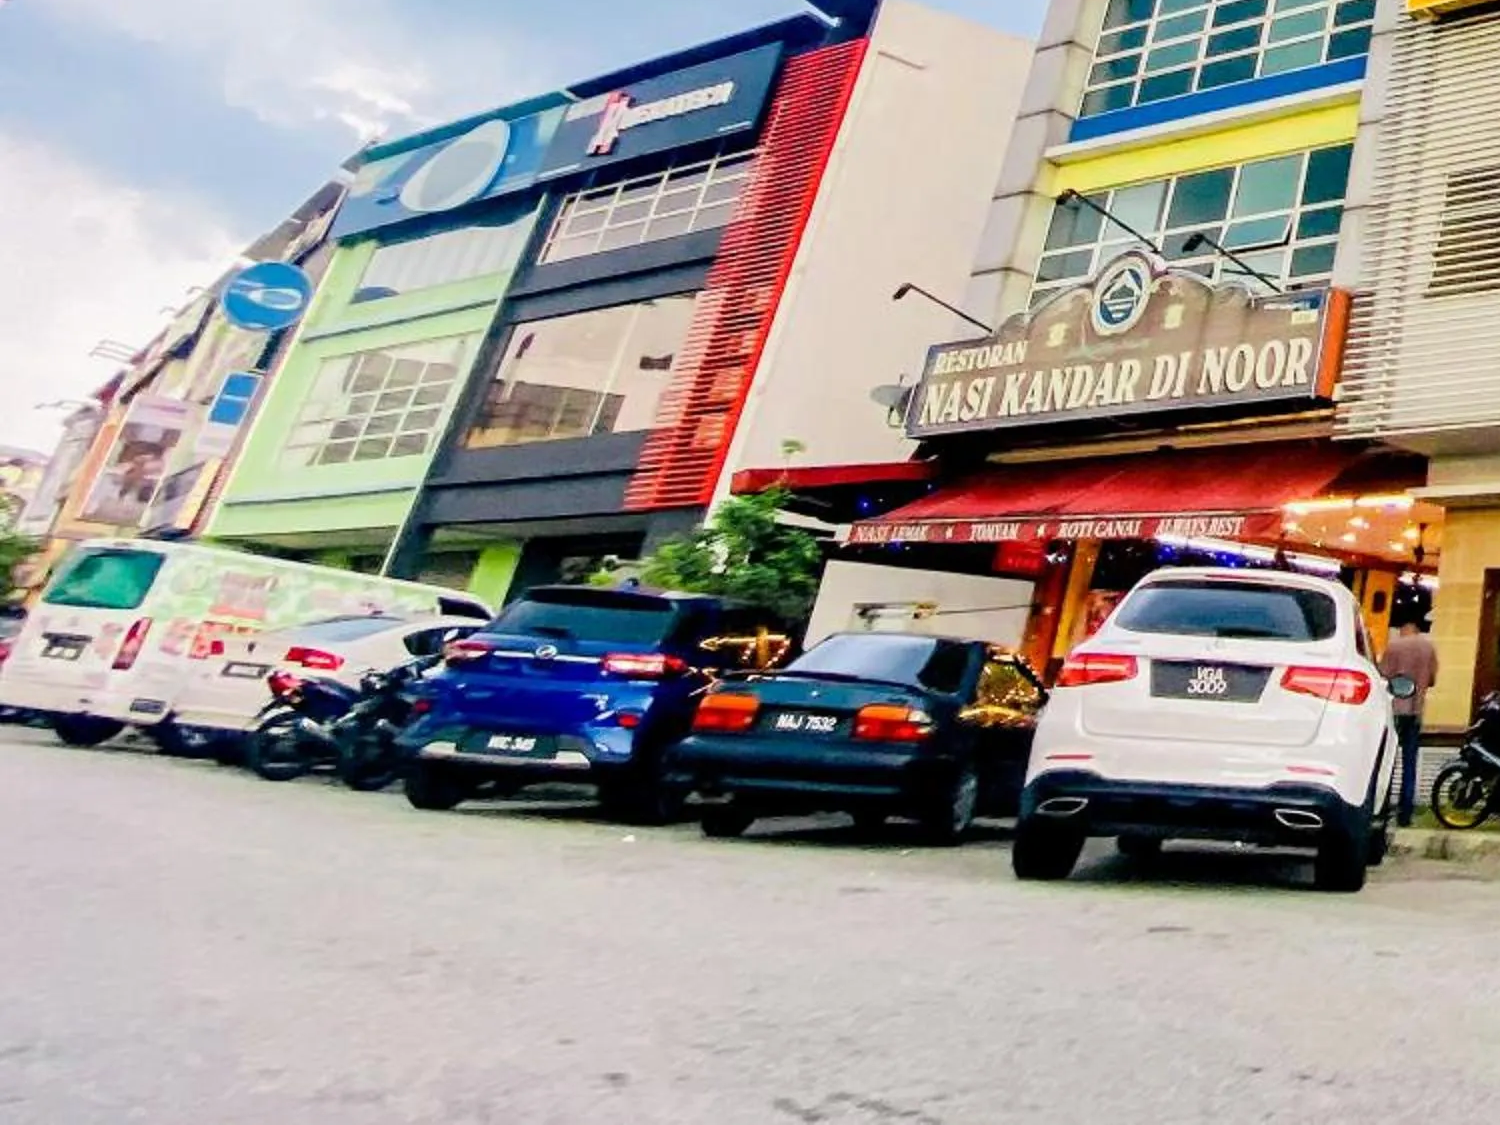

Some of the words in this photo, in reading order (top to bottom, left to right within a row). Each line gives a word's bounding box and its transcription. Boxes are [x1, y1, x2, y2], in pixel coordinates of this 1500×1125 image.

[933, 340, 1029, 375] RESTORAN
[919, 376, 997, 424] NASI
[998, 359, 1142, 417] KANDAR
[1146, 351, 1193, 400] DI
[1196, 337, 1313, 395] NOOR
[1057, 521, 1095, 538] ROTI
[1206, 516, 1246, 536] BEST
[1187, 678, 1227, 694] 3009
